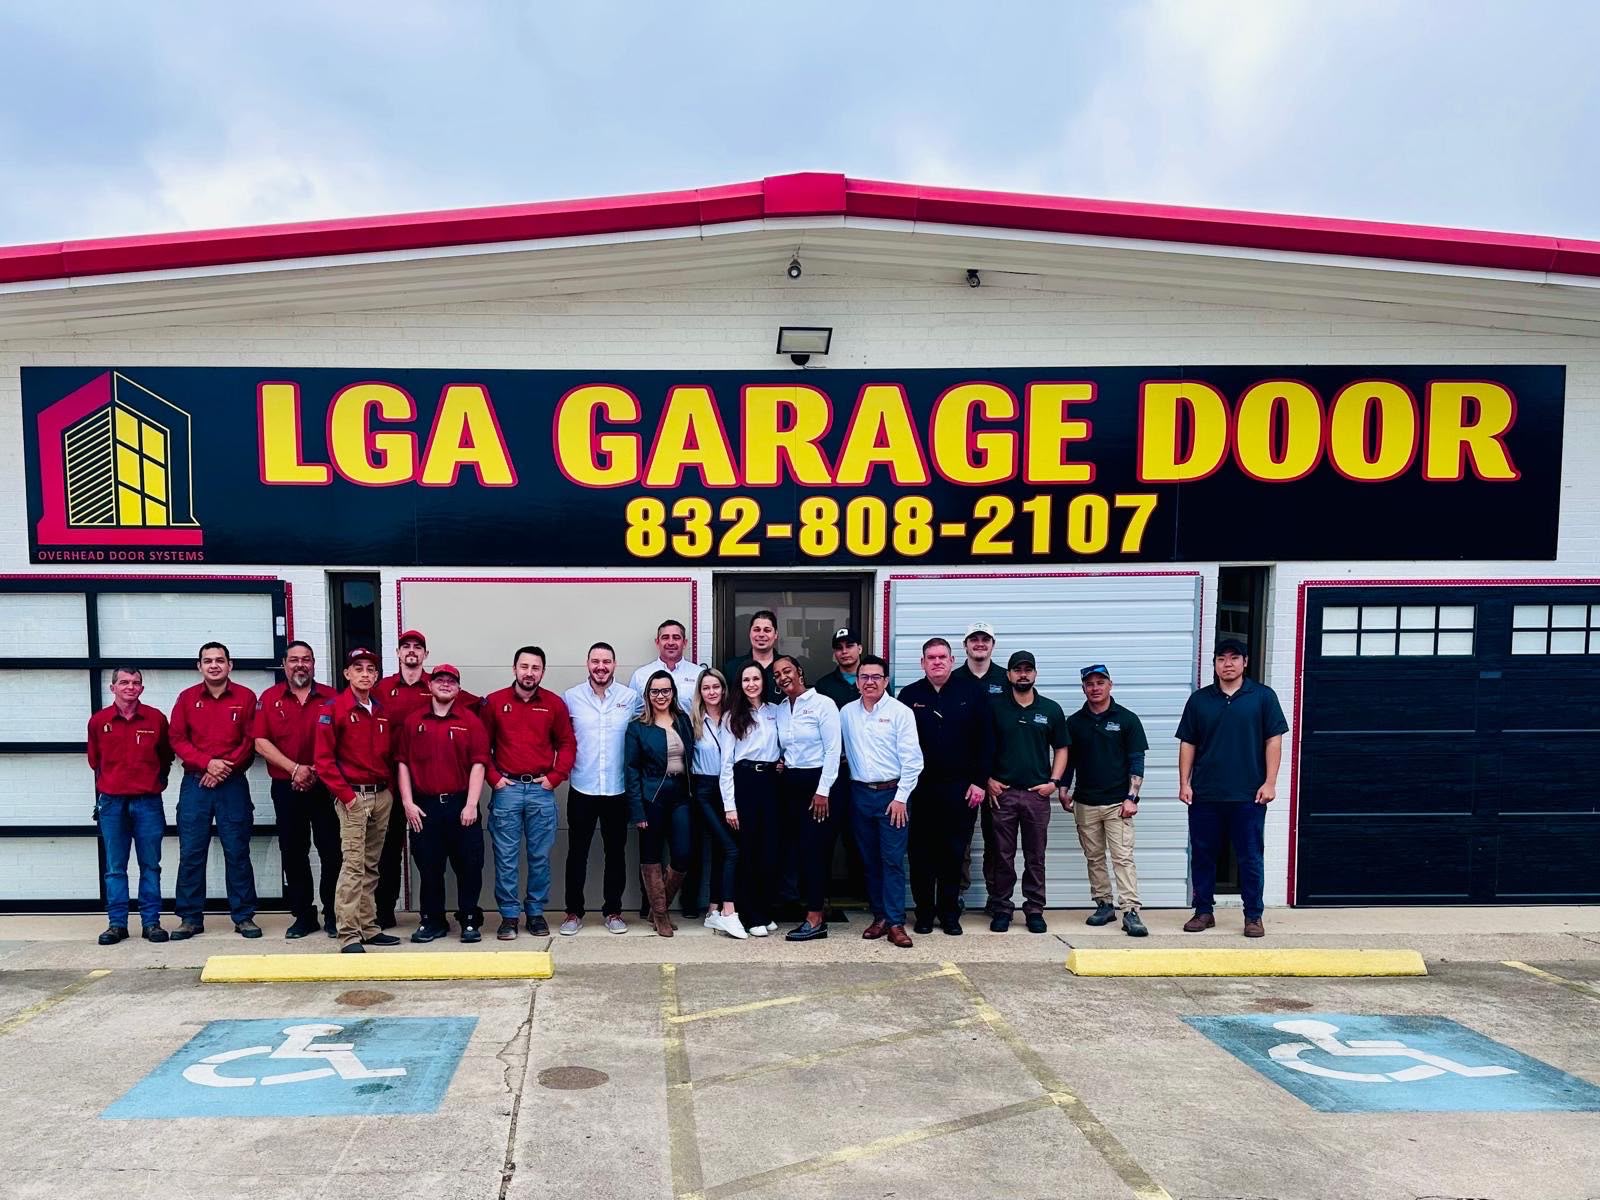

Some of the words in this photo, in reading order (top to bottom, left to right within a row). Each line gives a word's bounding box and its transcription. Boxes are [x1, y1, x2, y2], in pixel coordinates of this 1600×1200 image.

[257, 381, 518, 487] LGA
[553, 381, 1097, 488] GARAGE
[1136, 379, 1521, 483] DOOR
[38, 551, 105, 561] OVERHEAD
[109, 551, 145, 561] DOOR
[149, 551, 204, 561] SYSTEMS
[624, 493, 1159, 557] 832-808-2107
